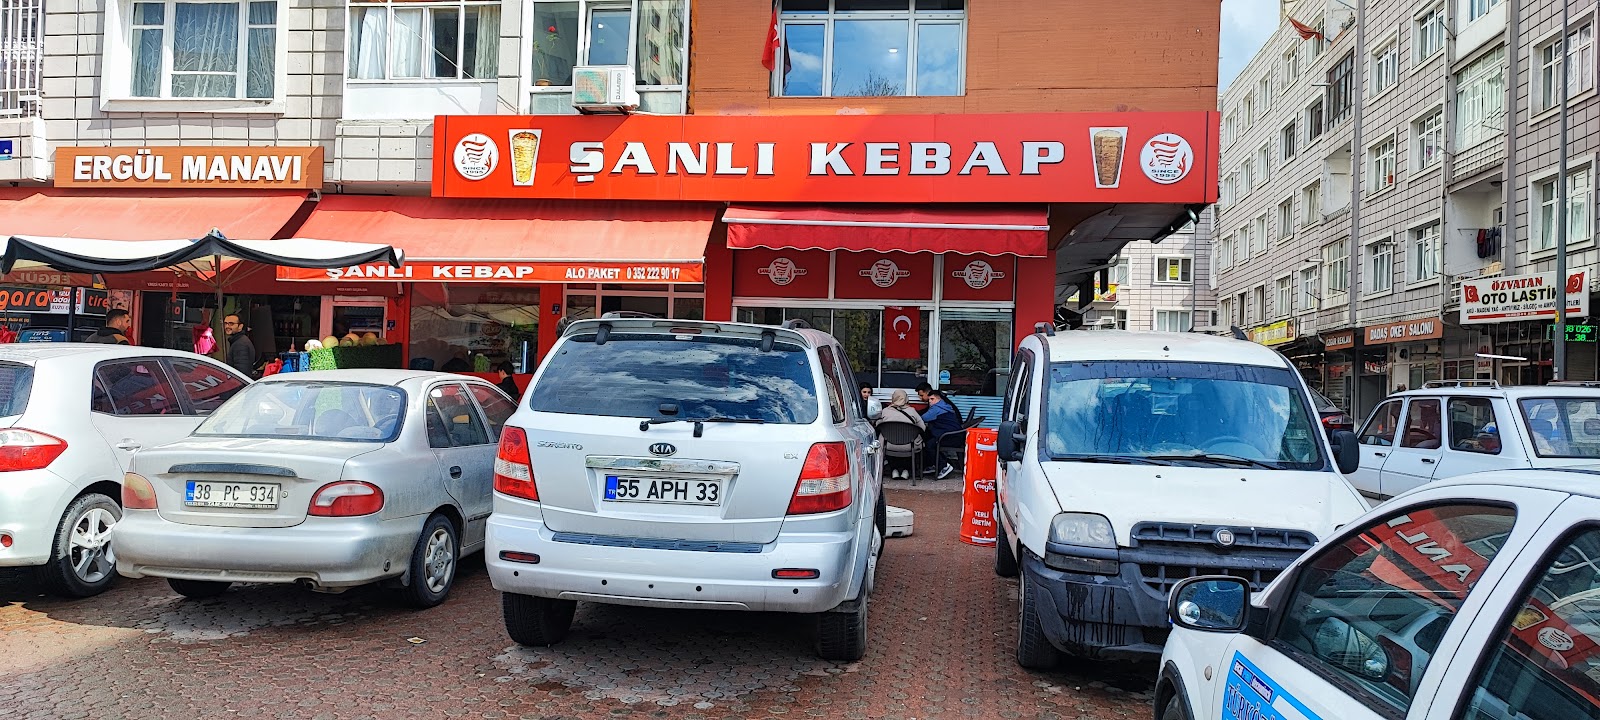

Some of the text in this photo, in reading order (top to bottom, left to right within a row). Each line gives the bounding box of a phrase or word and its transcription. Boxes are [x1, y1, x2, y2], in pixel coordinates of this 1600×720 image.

[73, 149, 302, 181] ERGÜL MANAVI
[569, 141, 1065, 182] ŞANLI KEBAP
[326, 265, 680, 280] ŞANLI KEBAP ALO PAKET 0 352 222 90 17
[1491, 276, 1543, 292] ÖZVATAN
[1481, 292, 1508, 305] OTO
[1370, 321, 1434, 341] DADAŞ OKEY SALONU
[537, 440, 583, 450] SORENTO
[653, 445, 673, 454] KIA
[784, 452, 798, 460] EX
[195, 484, 211, 500] 38
[223, 485, 240, 501] PC
[249, 486, 274, 502] 934
[617, 479, 640, 499] 55
[646, 480, 688, 501] APH
[695, 482, 719, 502] 33
[974, 510, 989, 518] YERLİ
[971, 518, 992, 527] ÜRETİM
